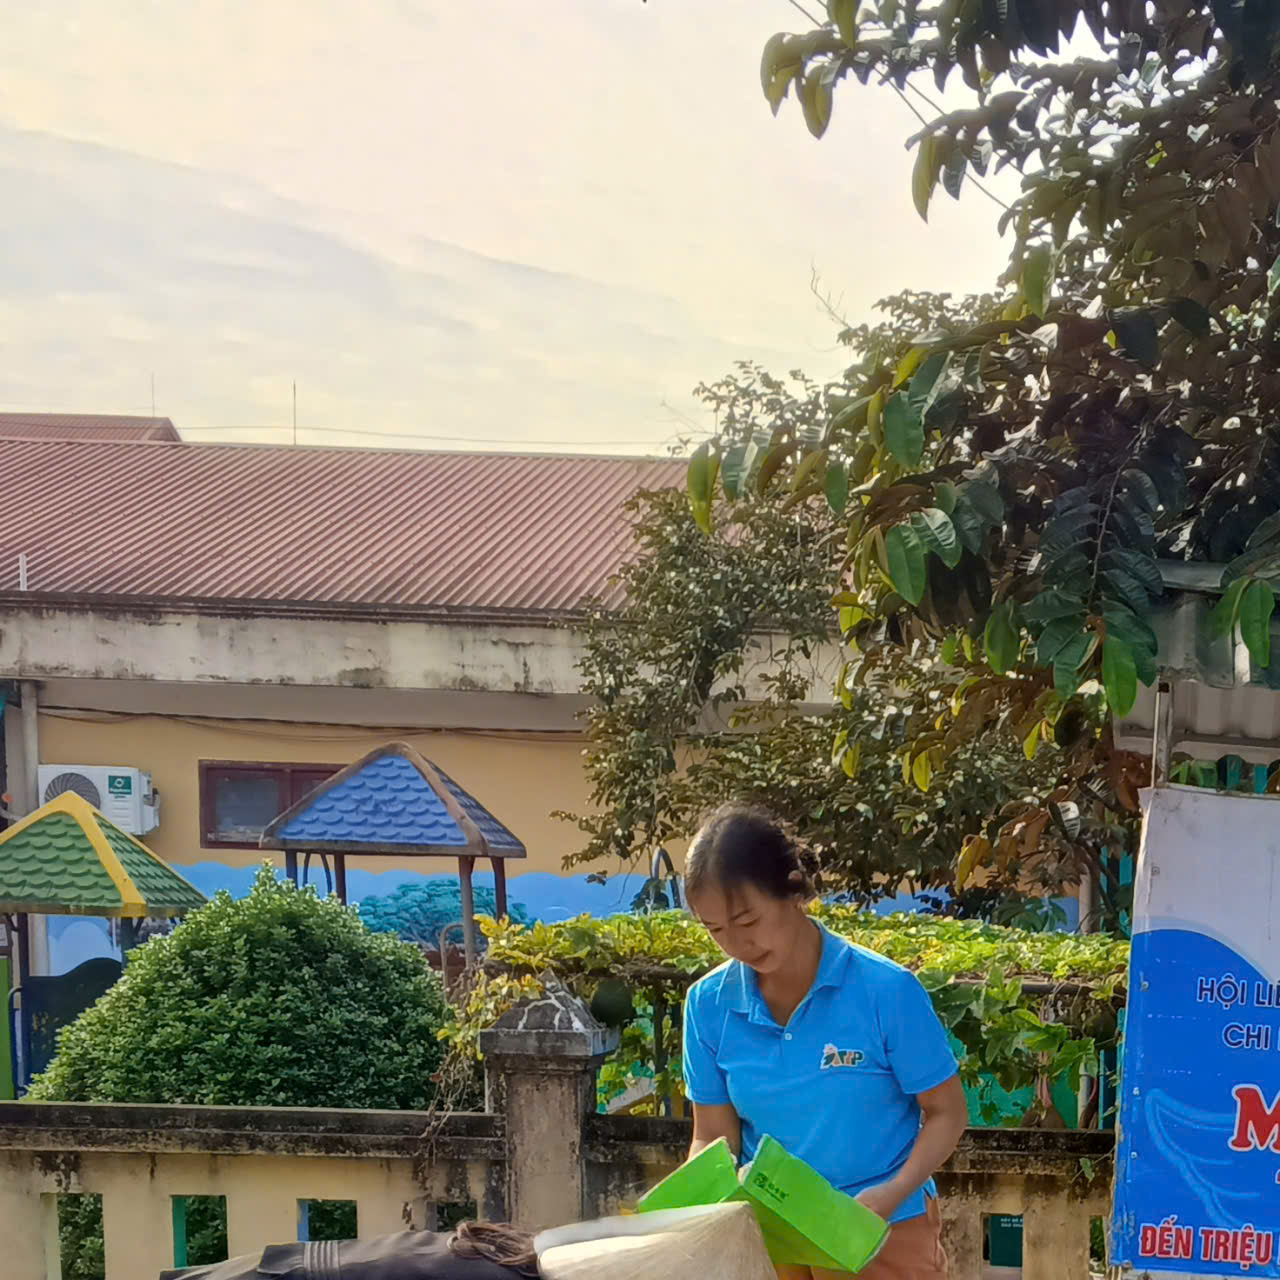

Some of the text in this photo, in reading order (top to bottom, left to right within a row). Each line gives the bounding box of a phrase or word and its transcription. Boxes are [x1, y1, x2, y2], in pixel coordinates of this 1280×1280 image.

[1197, 973, 1247, 1010] HỘI
[1223, 1022, 1270, 1049] CHI
[1139, 1215, 1193, 1259] ĐẾN
[1200, 1223, 1272, 1270] TRIỆU
